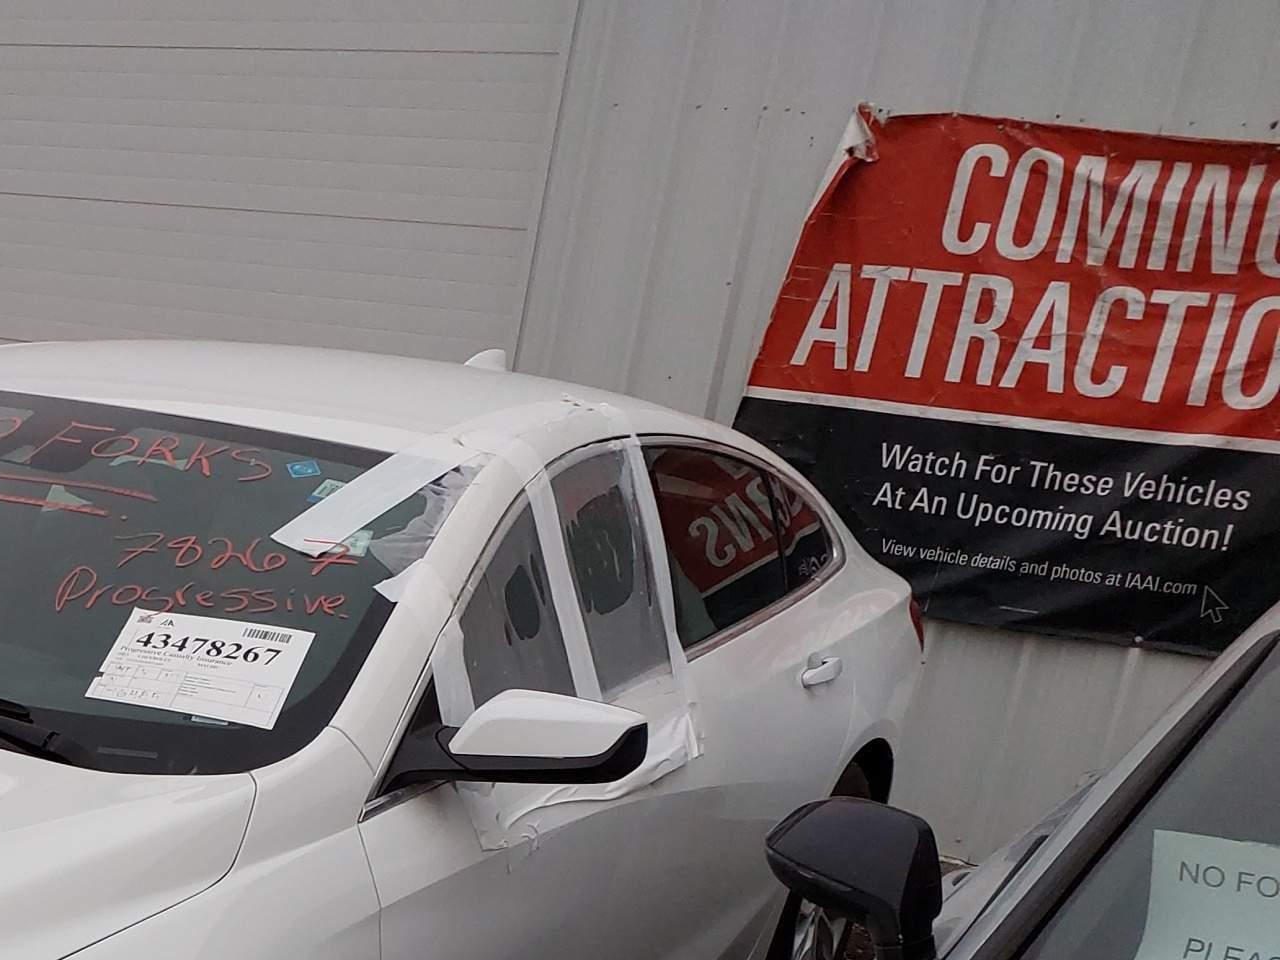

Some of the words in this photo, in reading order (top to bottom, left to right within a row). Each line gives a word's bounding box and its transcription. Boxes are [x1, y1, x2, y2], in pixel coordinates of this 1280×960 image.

[790, 263, 1280, 410] ATTRACTIO
[26, 420, 273, 481] FORKS
[881, 442, 967, 478] Watch
[974, 455, 1021, 484] For
[1029, 460, 1114, 496] These
[1123, 472, 1252, 511] Vehicles
[872, 482, 906, 510] At
[909, 487, 947, 516] An
[956, 492, 1094, 540] Upcoming
[1100, 510, 1234, 551] Auction!
[115, 532, 359, 576] 78267
[881, 537, 916, 558] View
[920, 543, 969, 566] vehicle
[971, 553, 1017, 573] details
[1020, 559, 1048, 577] and
[1050, 563, 1101, 586] photos
[1105, 572, 1122, 588] at
[1125, 572, 1197, 596] IAAI.com
[136, 631, 282, 667] 43478267
[1179, 861, 1226, 888] NO
[1236, 871, 1280, 898] FO
